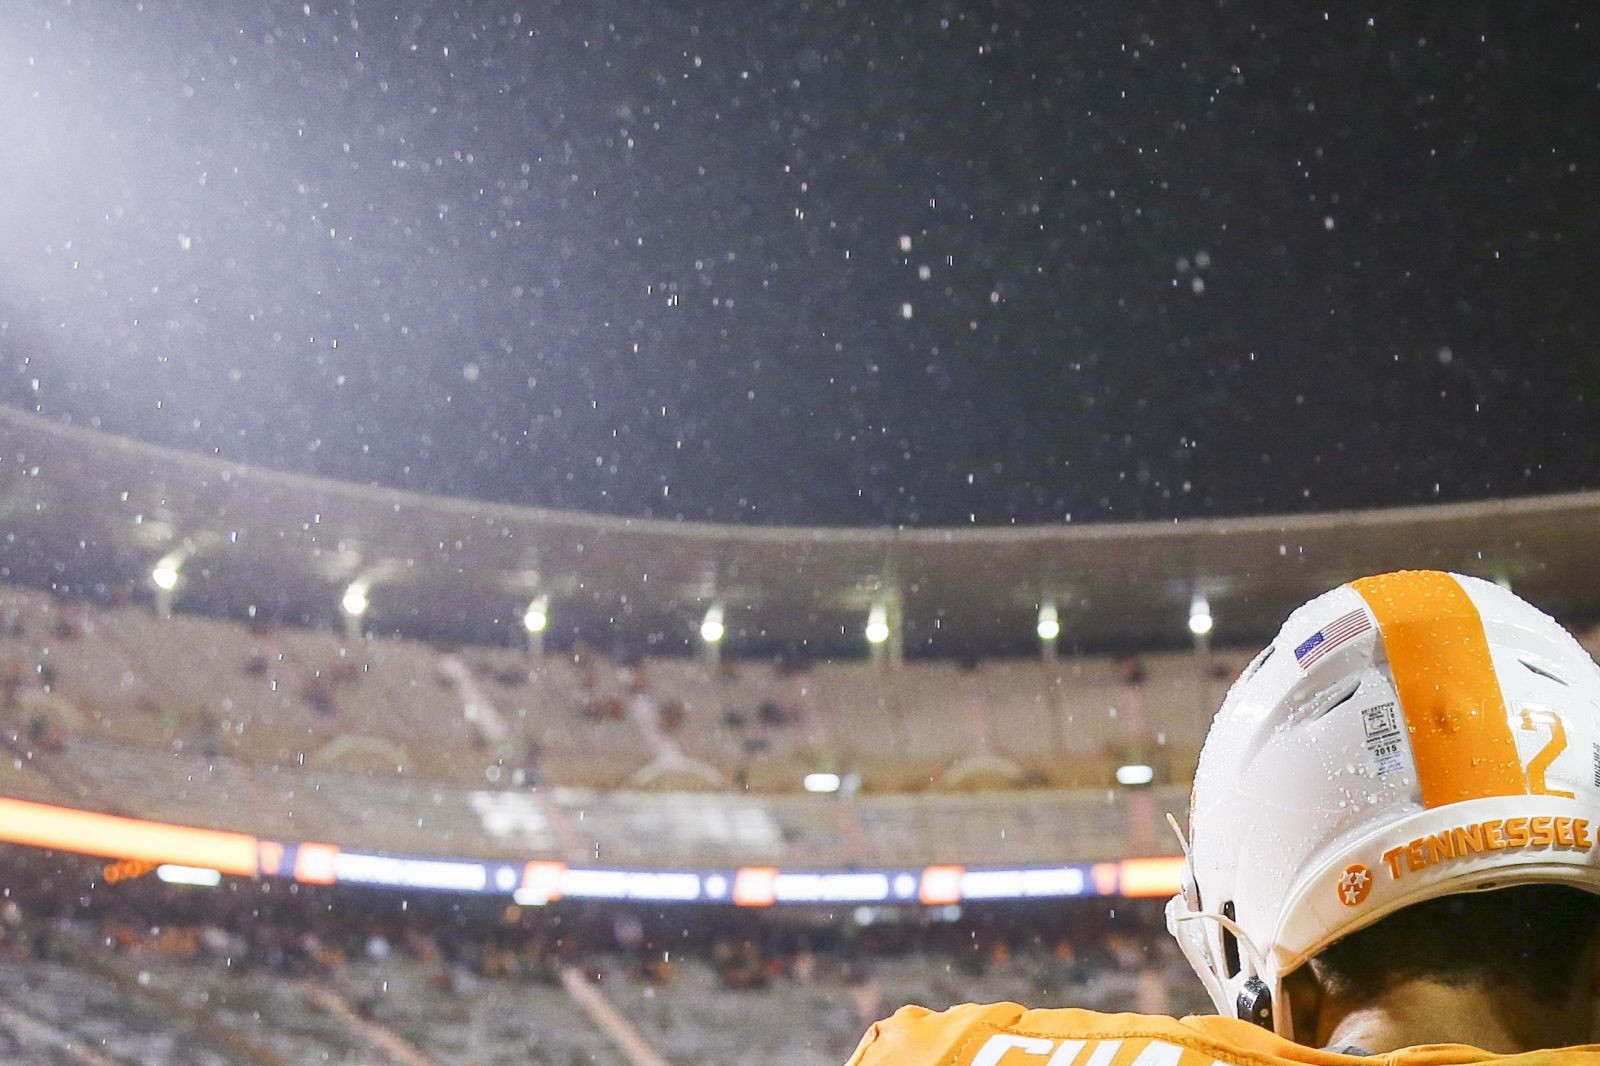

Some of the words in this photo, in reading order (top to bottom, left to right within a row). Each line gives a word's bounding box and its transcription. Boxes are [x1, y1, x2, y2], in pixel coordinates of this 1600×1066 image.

[1375, 745, 1397, 756] 2015
[1519, 708, 1576, 800] 2
[1382, 815, 1593, 880] TENNESSEE
